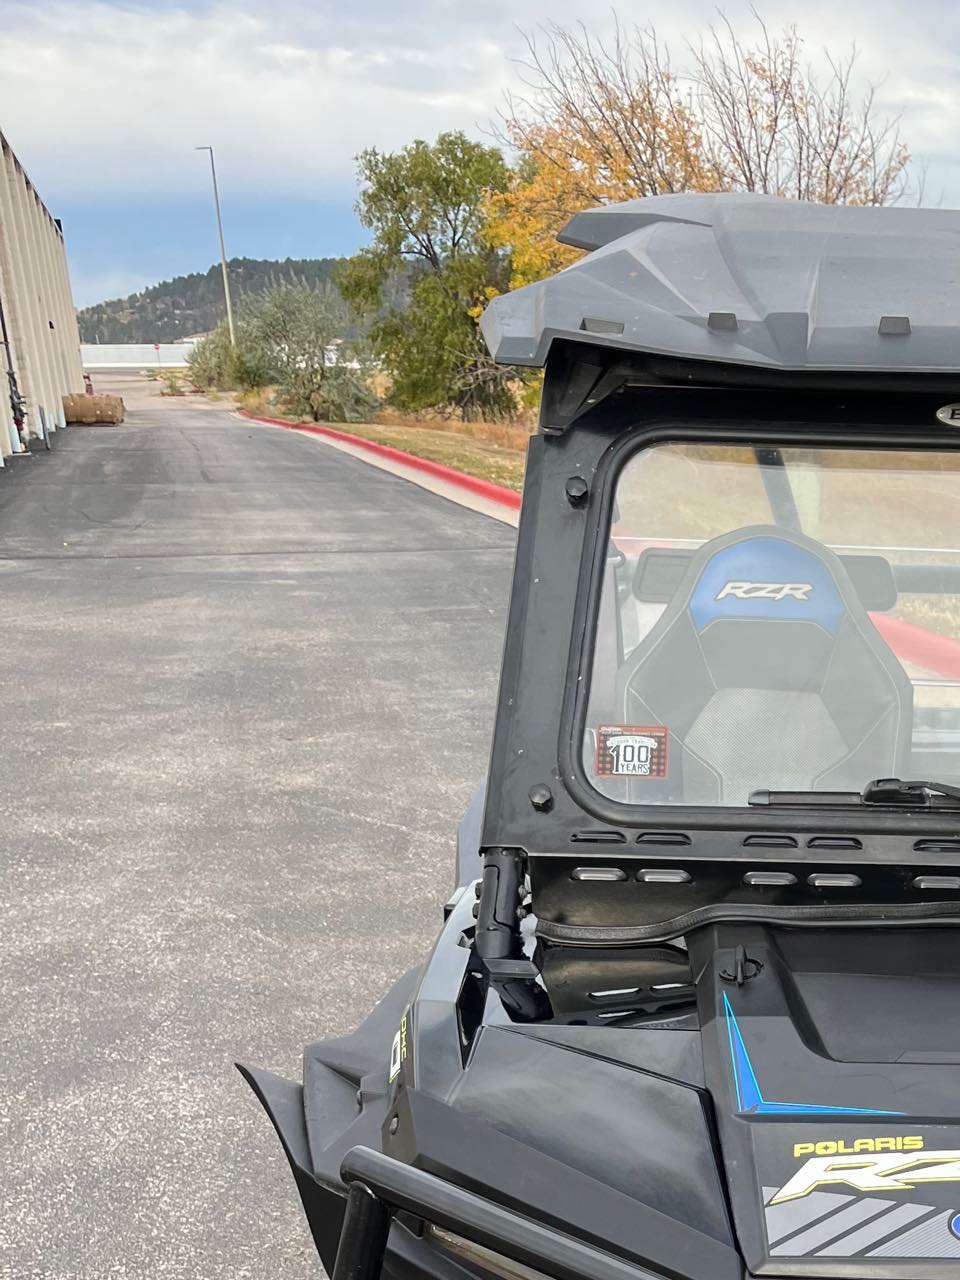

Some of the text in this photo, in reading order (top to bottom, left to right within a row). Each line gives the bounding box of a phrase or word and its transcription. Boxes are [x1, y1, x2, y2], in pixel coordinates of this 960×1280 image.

[715, 581, 815, 602] RZR
[611, 745, 649, 772] 100
[620, 763, 649, 774] YEARS
[793, 1135, 924, 1158] POLARIS
